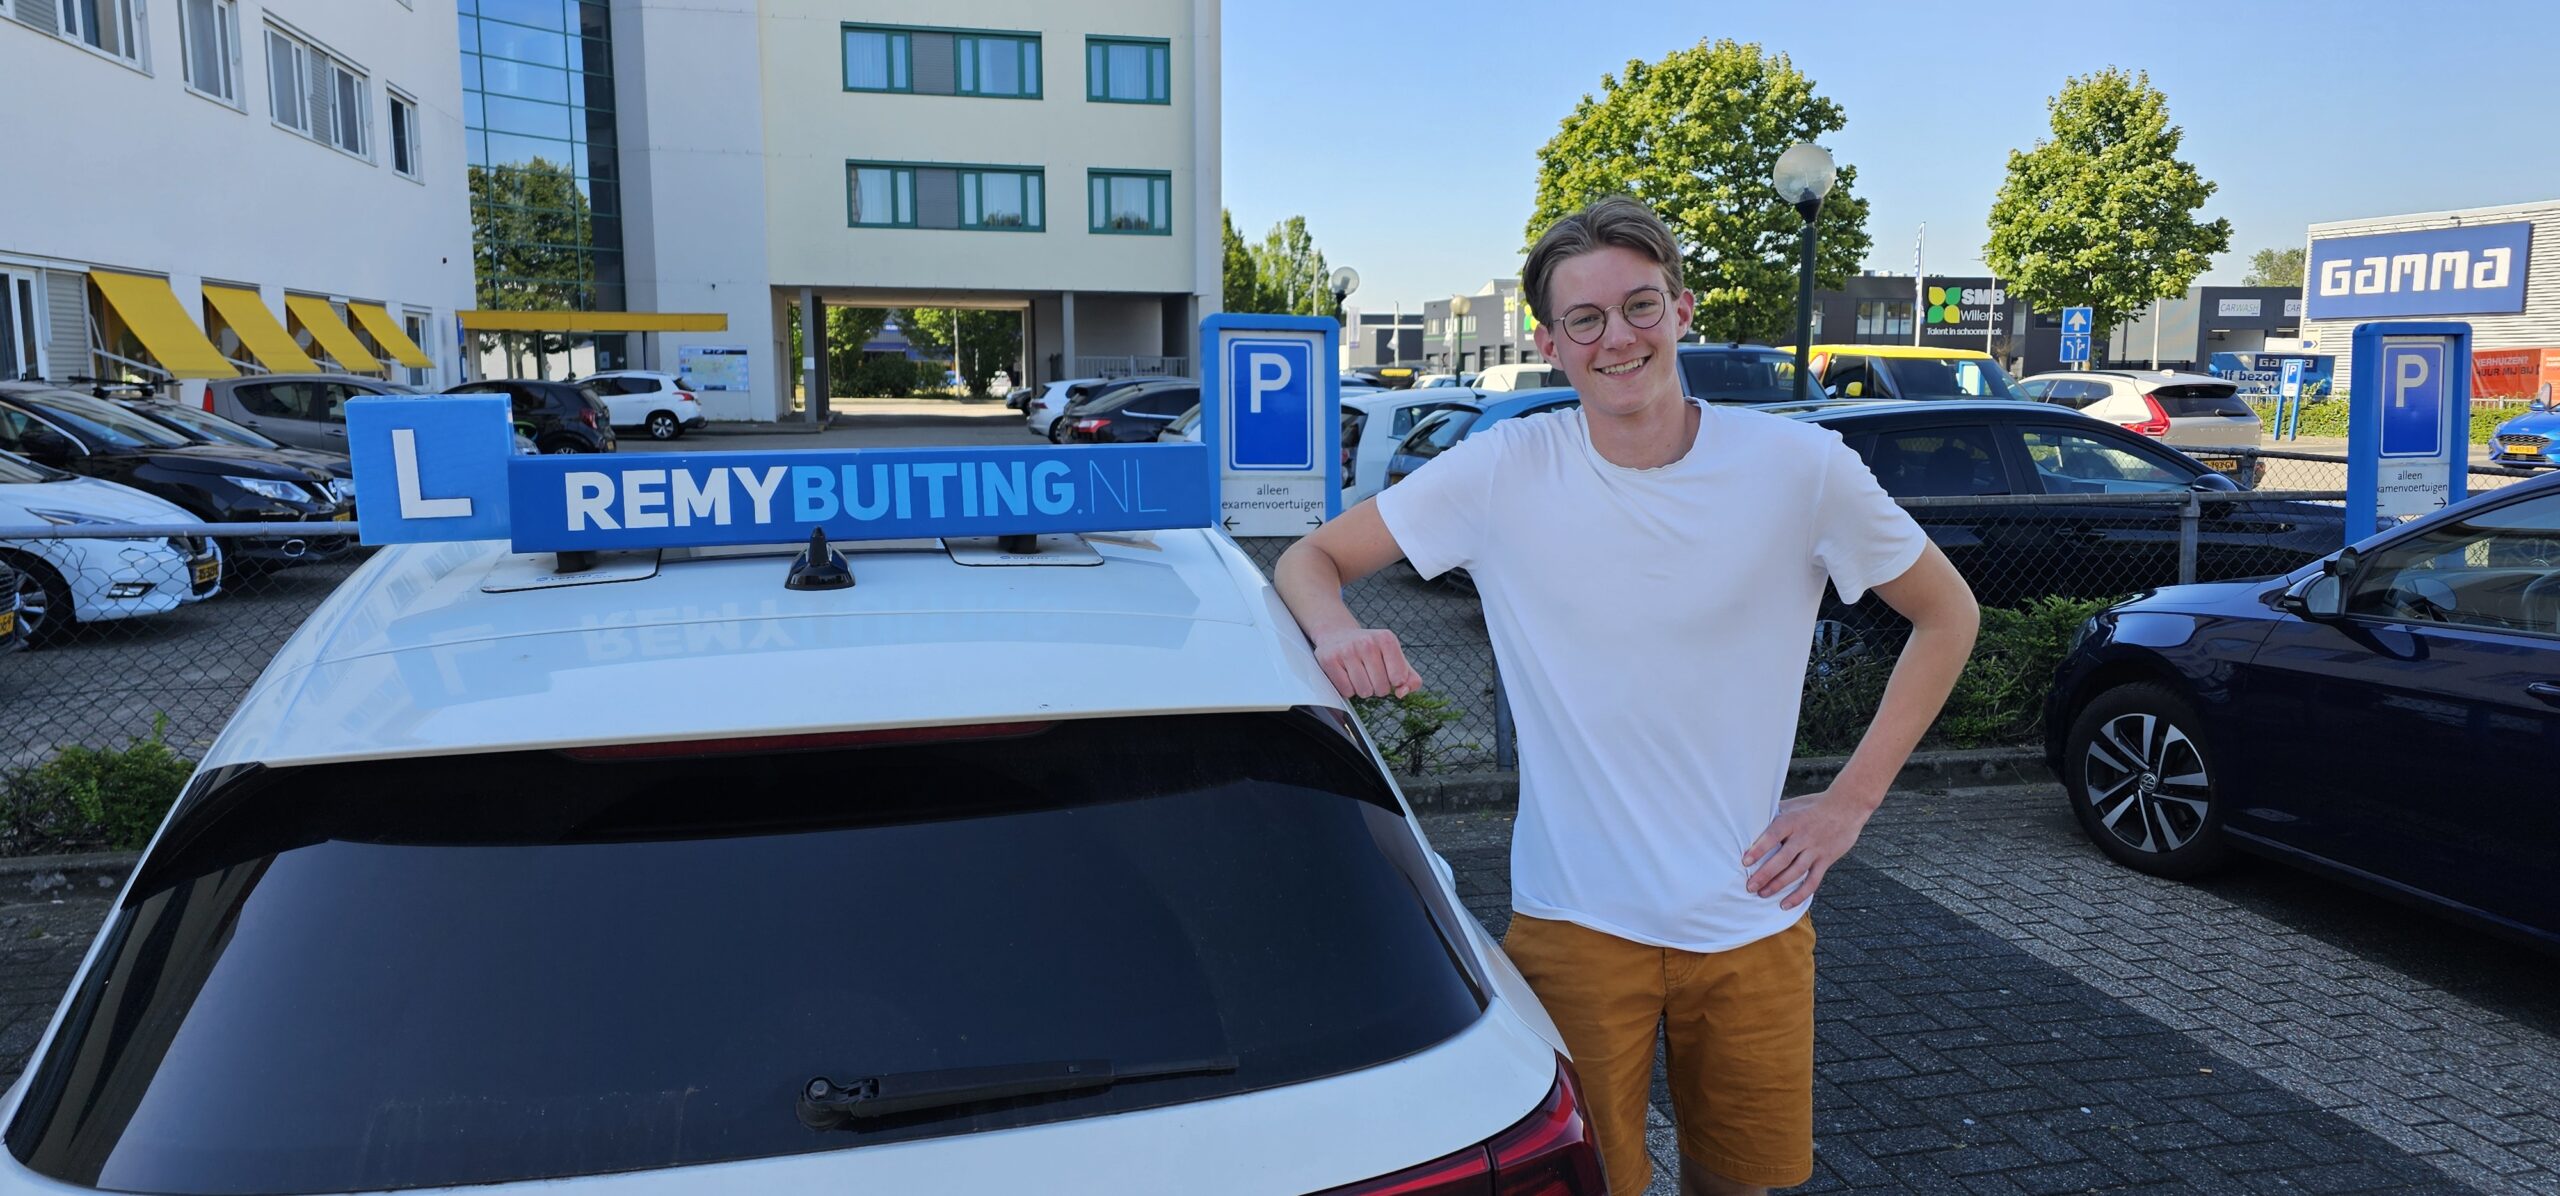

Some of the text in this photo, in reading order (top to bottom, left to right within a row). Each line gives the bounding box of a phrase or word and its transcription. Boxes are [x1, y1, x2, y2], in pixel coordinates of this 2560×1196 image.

[2320, 247, 2512, 297] GAMMA
[1961, 288, 2005, 305] SMB
[2220, 303, 2259, 312] CARWASH
[1960, 309, 2003, 321] Willems
[1250, 353, 1292, 413] P
[2395, 354, 2429, 408] P
[391, 429, 473, 520] L
[2397, 470, 2423, 481] alleen
[1256, 484, 1289, 496] alleen
[2377, 482, 2448, 494] amenvoertuigen
[1221, 499, 1324, 512] examenvoertuigen
